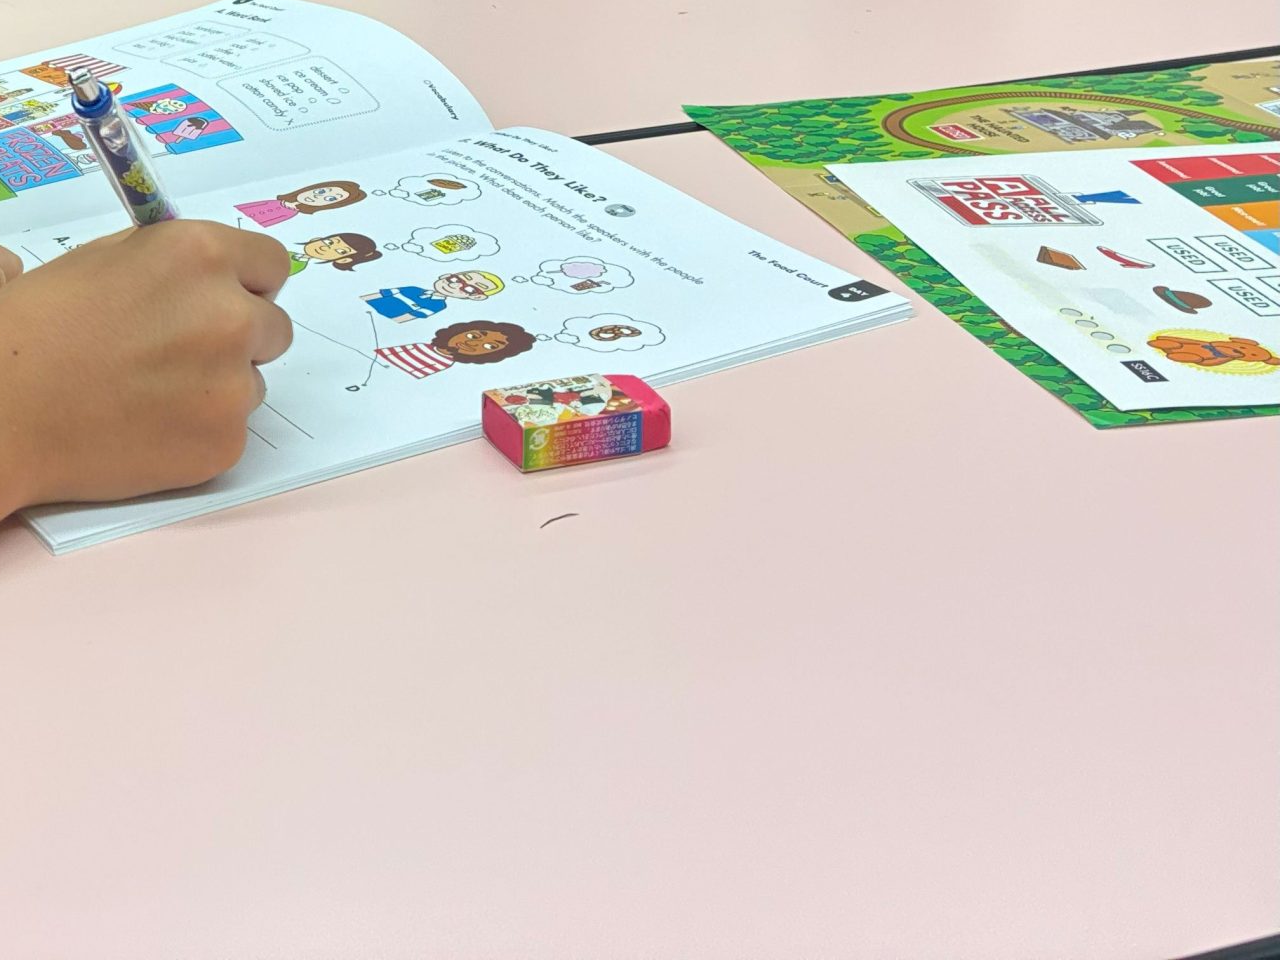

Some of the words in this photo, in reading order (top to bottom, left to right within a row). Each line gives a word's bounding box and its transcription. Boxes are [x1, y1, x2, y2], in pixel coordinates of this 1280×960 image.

[276, 74, 289, 83] ice
[286, 81, 304, 94] pop
[293, 70, 306, 79] ice
[304, 77, 328, 97] cream
[310, 65, 339, 85] dessert
[242, 82, 265, 98] cotton
[262, 97, 288, 117] candy
[258, 78, 291, 97] shaved
[283, 96, 296, 107] ice
[3, 130, 73, 178] FROZEN
[473, 140, 511, 153] What
[508, 152, 529, 163] Do
[530, 161, 566, 181] They
[564, 180, 607, 202] Like?
[479, 173, 505, 188] What
[501, 187, 523, 200] does
[522, 200, 547, 213] each
[540, 212, 576, 231] person
[575, 229, 602, 243] like?
[941, 180, 1024, 221] PASS
[542, 197, 574, 214] Match
[571, 213, 588, 223] the
[587, 223, 629, 247] speakers
[629, 245, 652, 258] with
[650, 257, 668, 267] the
[664, 266, 704, 285] people
[1166, 244, 1206, 266] USED
[1214, 241, 1255, 263] USED
[748, 249, 767, 261] The
[768, 259, 798, 274] Food
[796, 271, 829, 289] Court
[848, 286, 870, 297] DAY
[1227, 285, 1271, 309] USED
